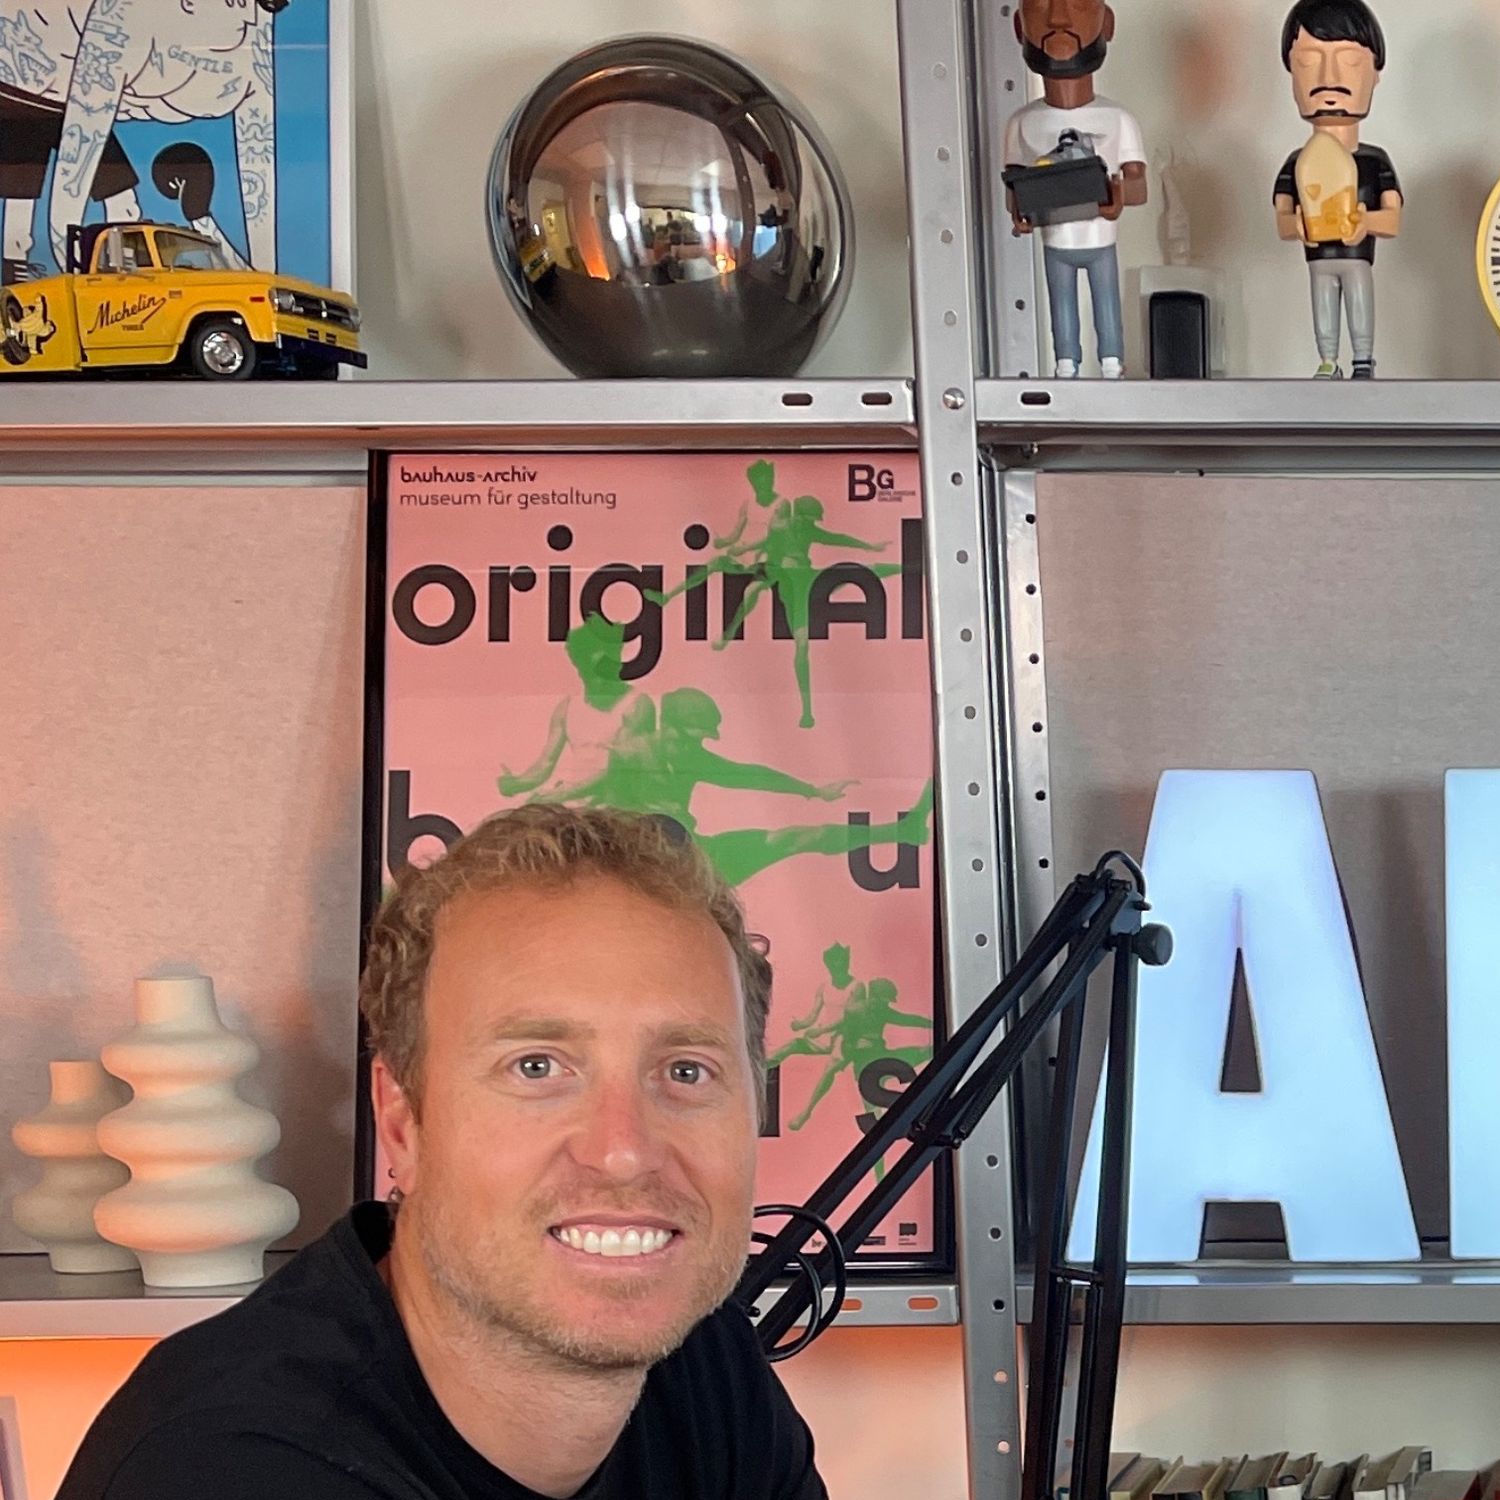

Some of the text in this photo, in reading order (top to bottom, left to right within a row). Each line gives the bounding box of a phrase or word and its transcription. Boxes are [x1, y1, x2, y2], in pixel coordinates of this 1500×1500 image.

[168, 45, 233, 73] GENTLE
[87, 294, 166, 334] Michelin
[400, 465, 538, 483] bauhaus-archiv
[400, 487, 617, 510] museum für gestaltung
